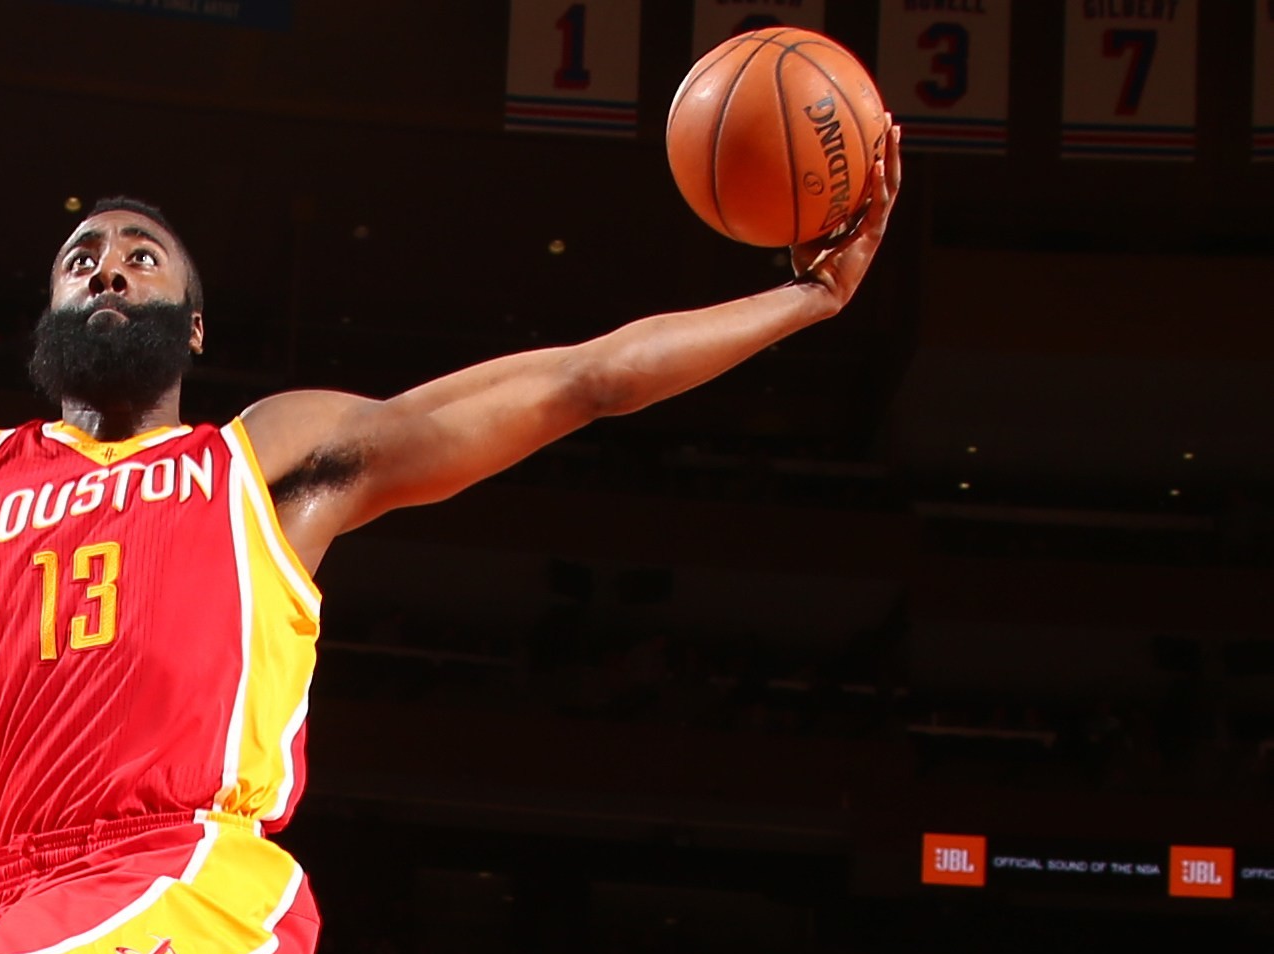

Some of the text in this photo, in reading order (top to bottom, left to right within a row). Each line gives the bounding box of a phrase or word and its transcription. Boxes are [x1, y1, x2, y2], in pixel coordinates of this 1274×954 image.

[554, 3, 590, 89] 1
[916, 22, 968, 108] 3
[1103, 29, 1157, 115] 7
[32, 541, 121, 661] 13
[935, 848, 975, 873] JBL
[993, 856, 1161, 875] OFFICIAL SOUND OF THE NBA
[1182, 860, 1222, 884] JBL
